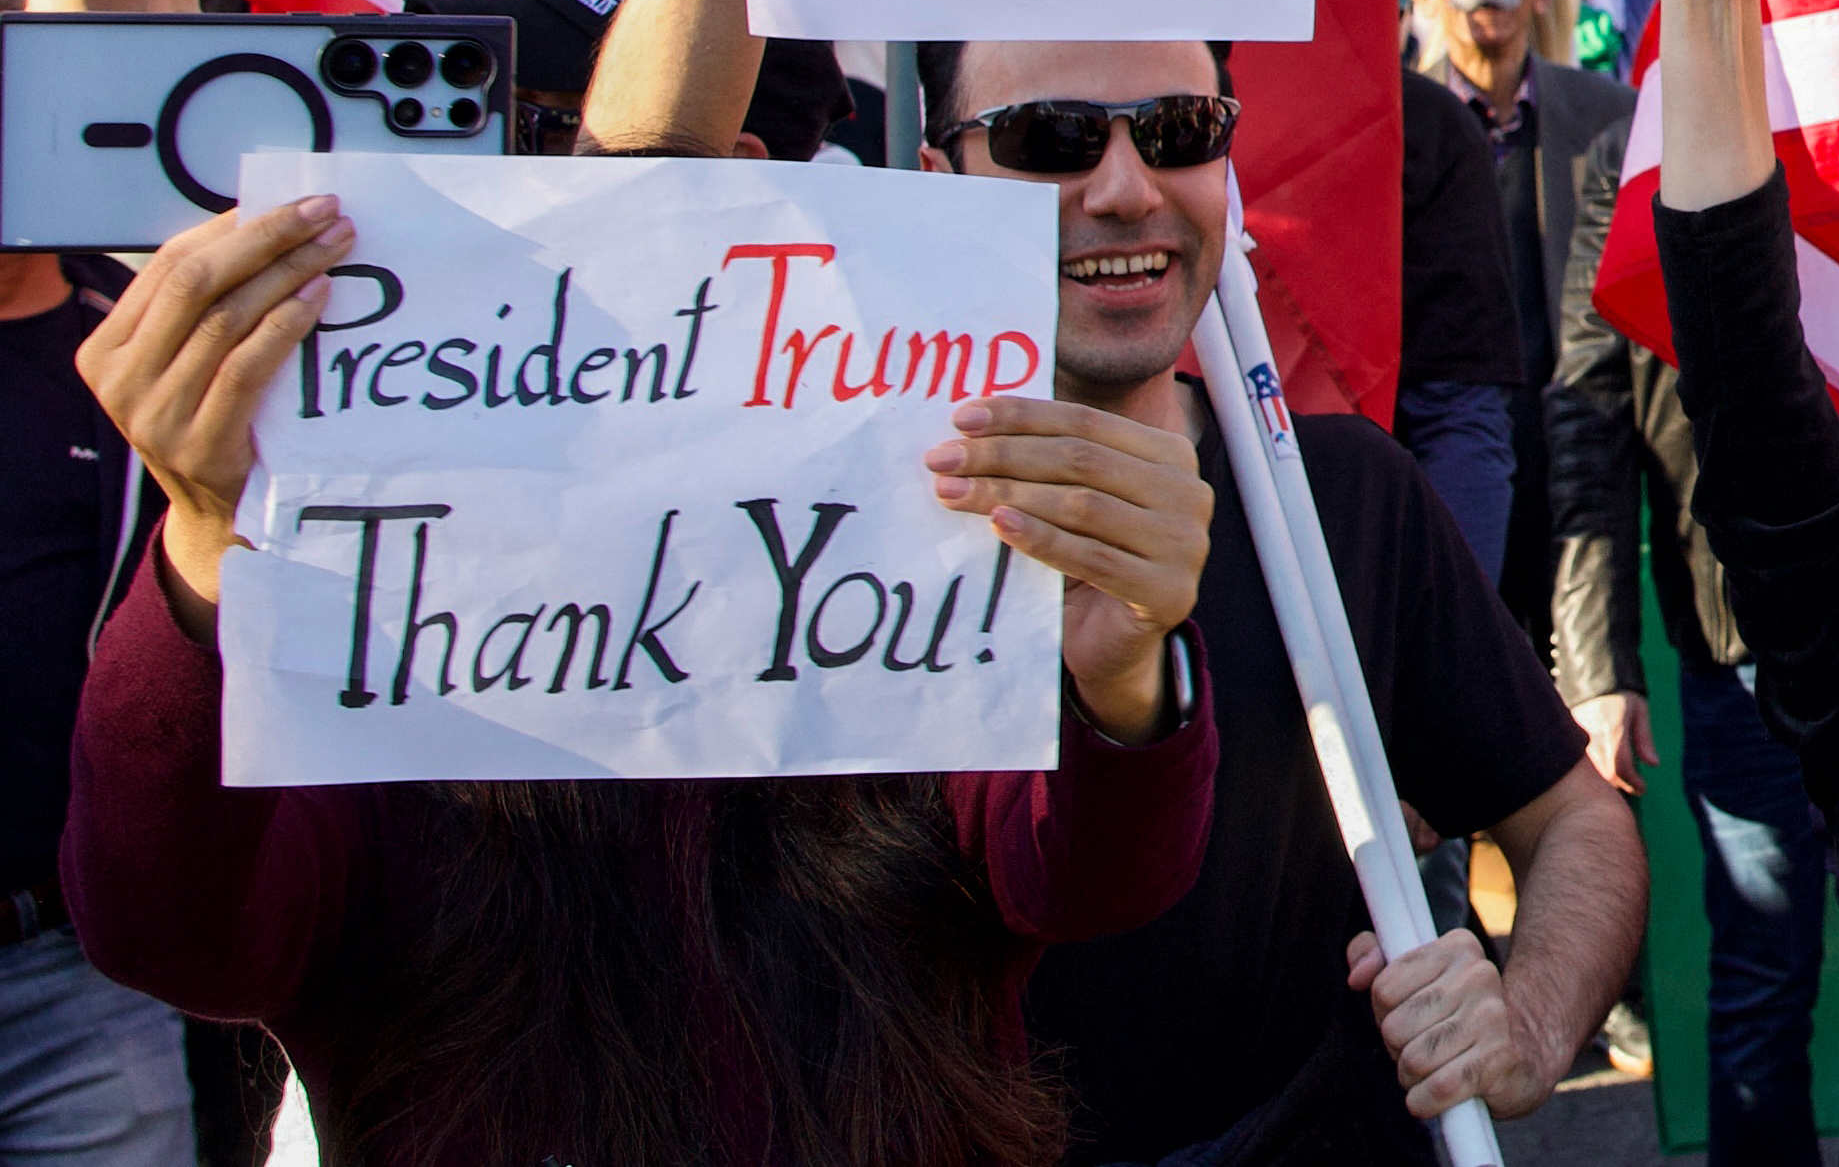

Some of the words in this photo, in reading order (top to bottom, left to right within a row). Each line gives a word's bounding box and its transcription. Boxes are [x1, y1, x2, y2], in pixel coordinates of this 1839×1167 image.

[295, 262, 718, 420] President
[721, 241, 1041, 412] Trump
[297, 503, 701, 710] Thank
[734, 497, 1013, 683] You!
